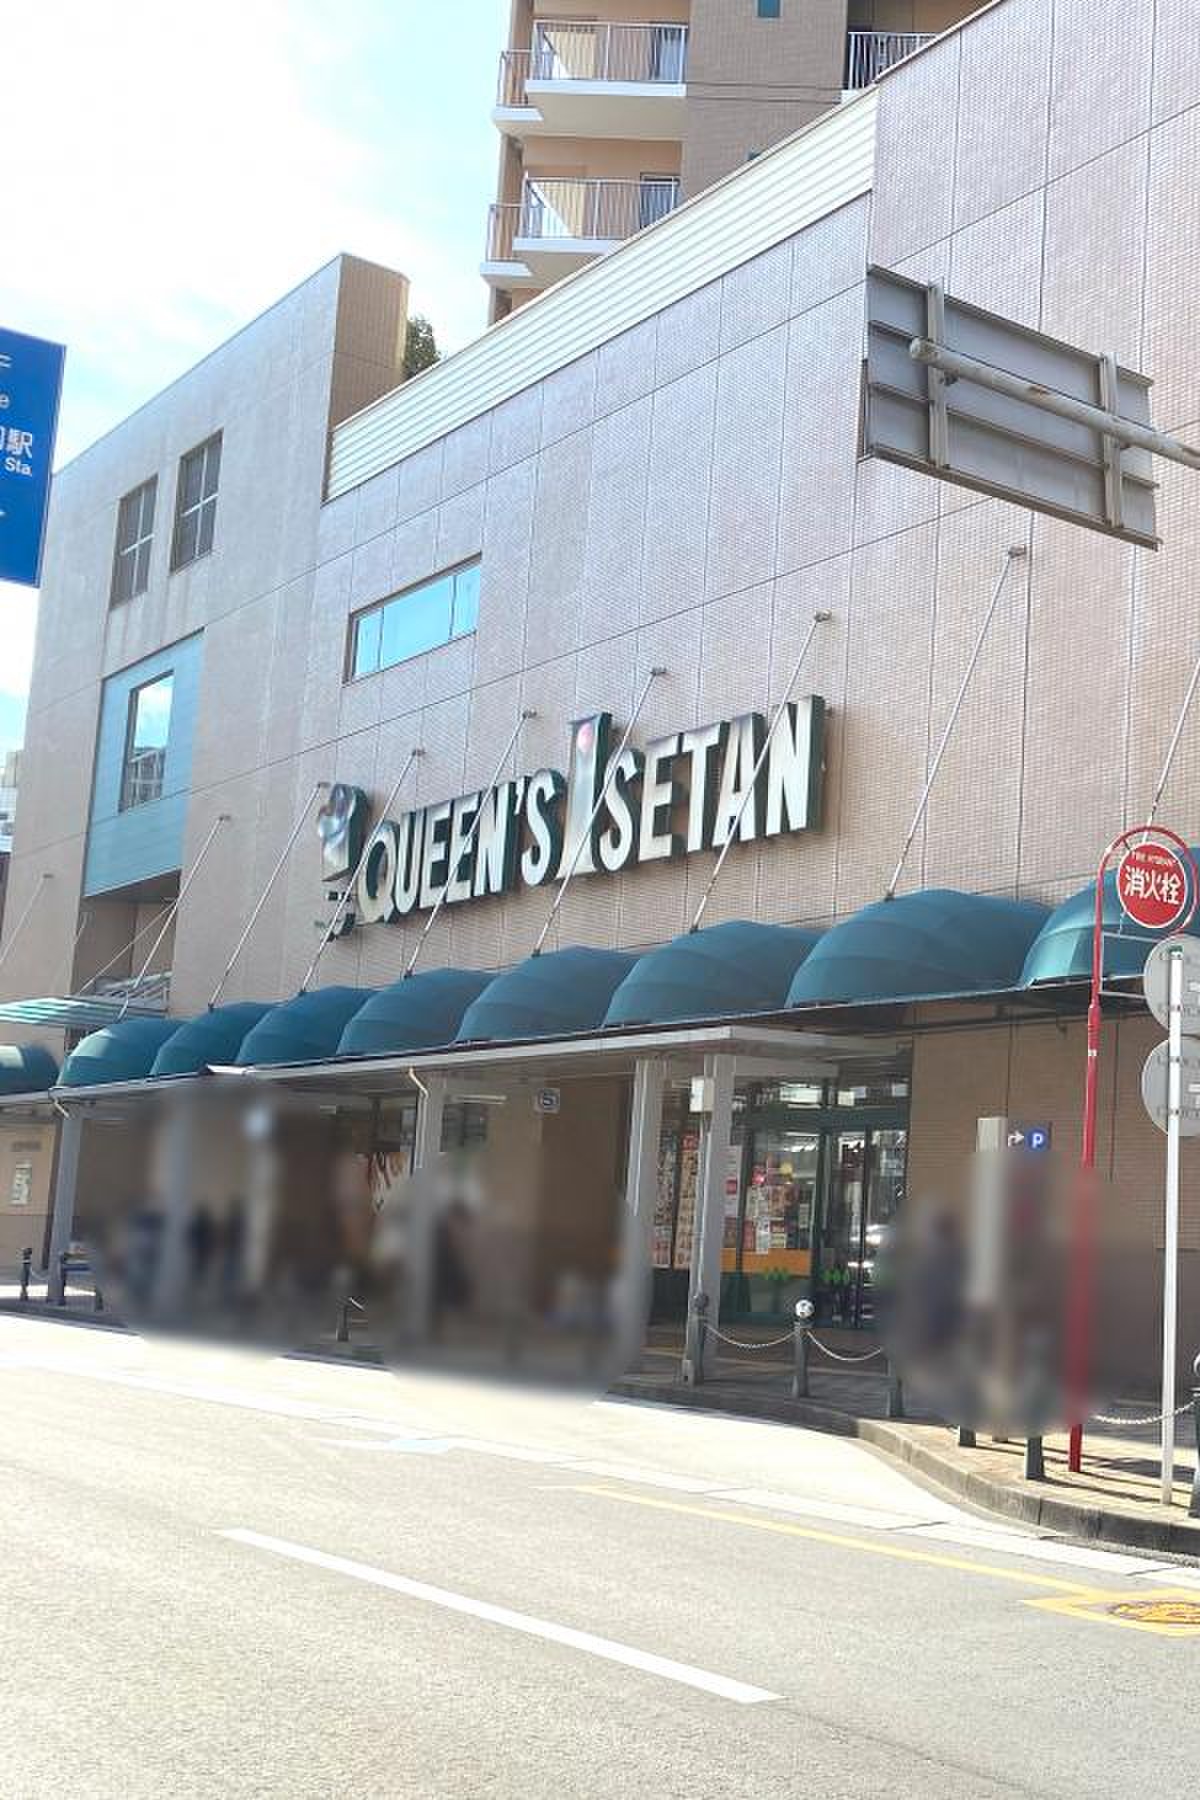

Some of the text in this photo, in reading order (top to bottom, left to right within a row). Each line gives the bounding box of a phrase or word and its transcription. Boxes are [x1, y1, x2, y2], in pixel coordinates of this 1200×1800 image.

[0, 425, 33, 459] 駅
[357, 695, 823, 925] QUEEN'S ISETAN
[1124, 866, 1182, 906] 消火栓
[1031, 1132, 1044, 1149] P
